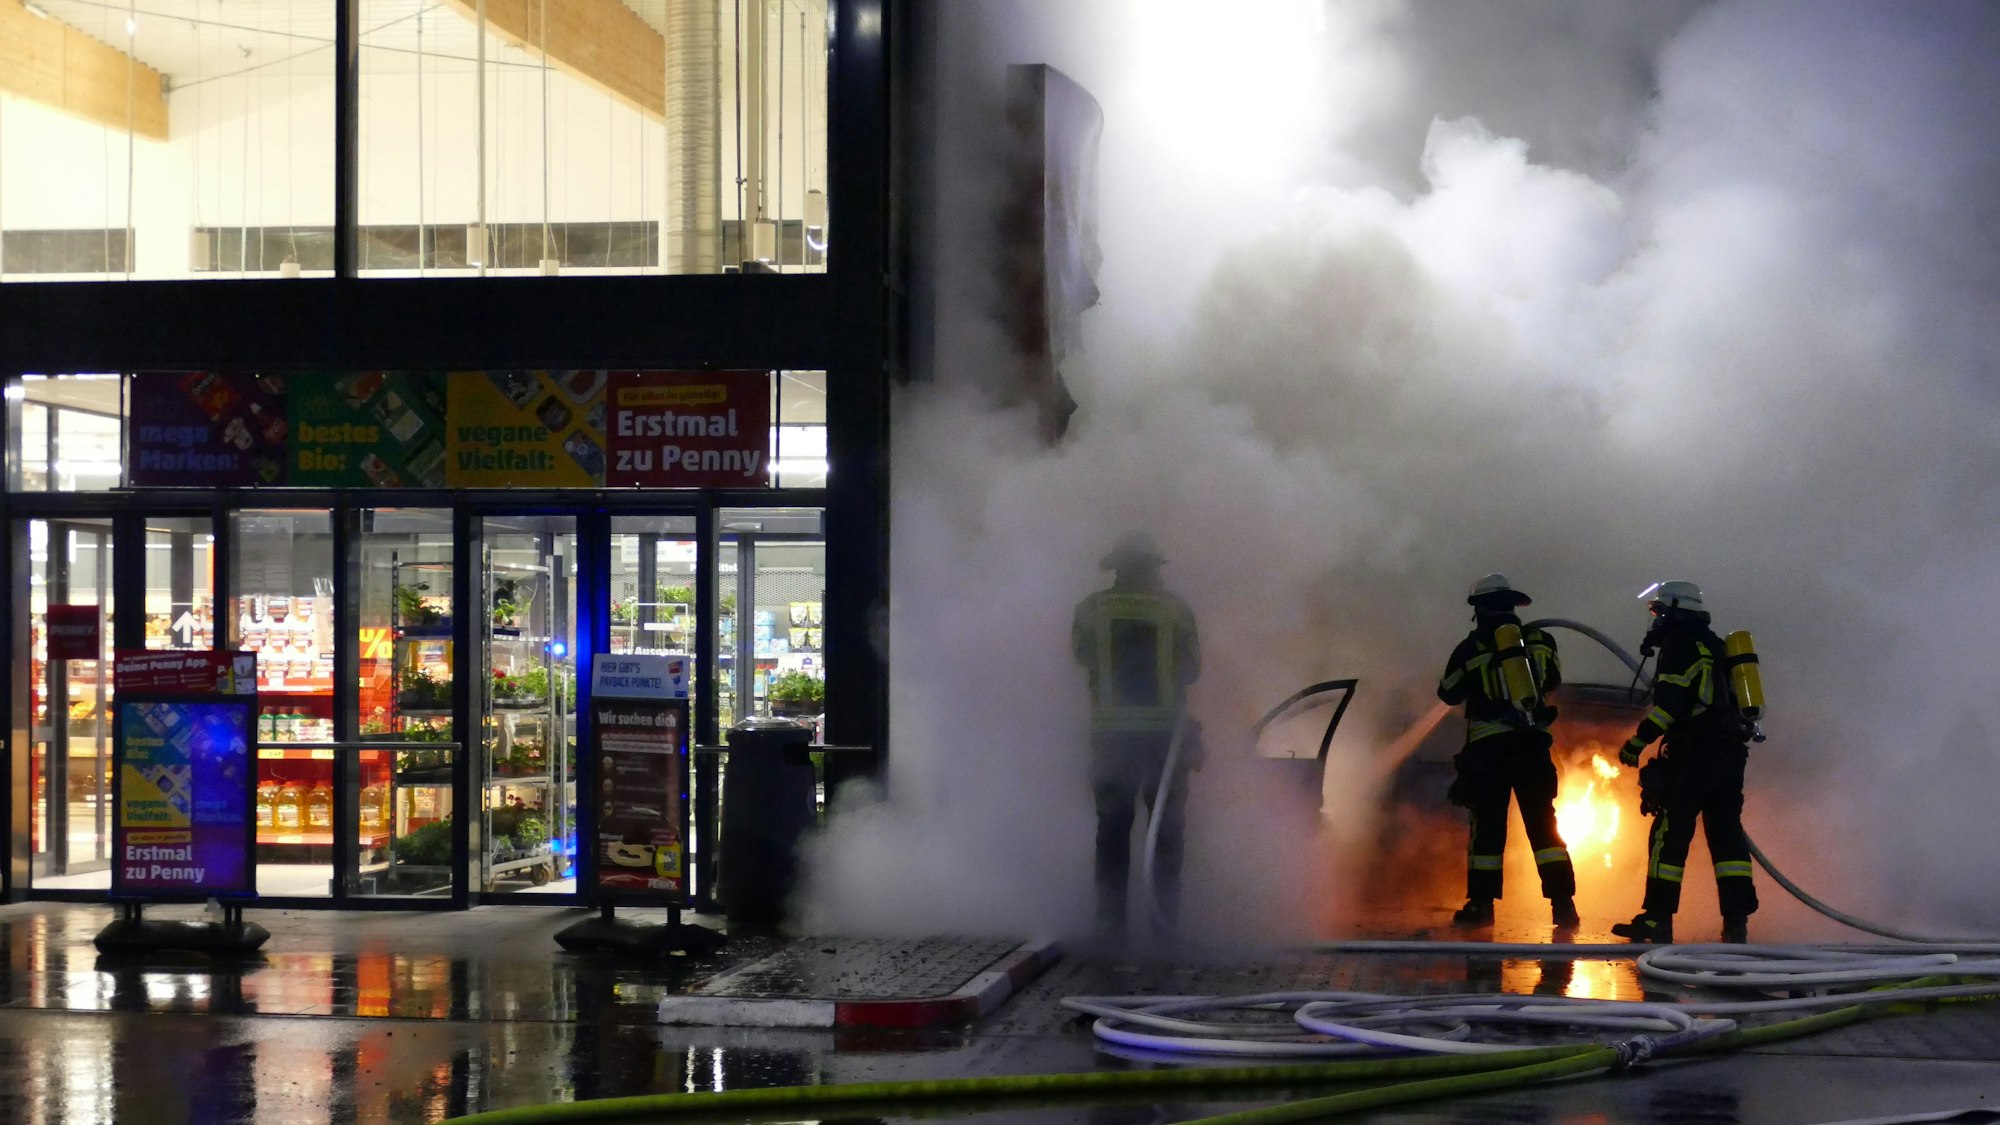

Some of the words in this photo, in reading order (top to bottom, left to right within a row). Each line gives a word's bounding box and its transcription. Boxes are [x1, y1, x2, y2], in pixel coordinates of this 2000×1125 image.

[297, 420, 380, 444] bestes
[617, 408, 739, 437] Erstmal
[138, 425, 209, 447] mega
[457, 425, 548, 447] vegane
[138, 448, 240, 471] Marken:
[297, 447, 346, 472] Bio:
[457, 447, 555, 471] Vielfalt:
[616, 449, 653, 471] zu
[662, 444, 761, 477] Penny
[116, 661, 149, 673] Deine
[150, 659, 184, 671] Penny
[600, 661, 617, 673] HIER
[618, 661, 641, 674] GIBT'S
[599, 676, 630, 688] PAYBACK
[631, 676, 662, 689] PUNKTE!
[598, 710, 617, 725] Wir
[617, 711, 654, 727] suchen
[655, 712, 677, 728] dich
[125, 845, 193, 862] Erstmal
[125, 866, 147, 880] zu
[150, 864, 206, 883] Penny
